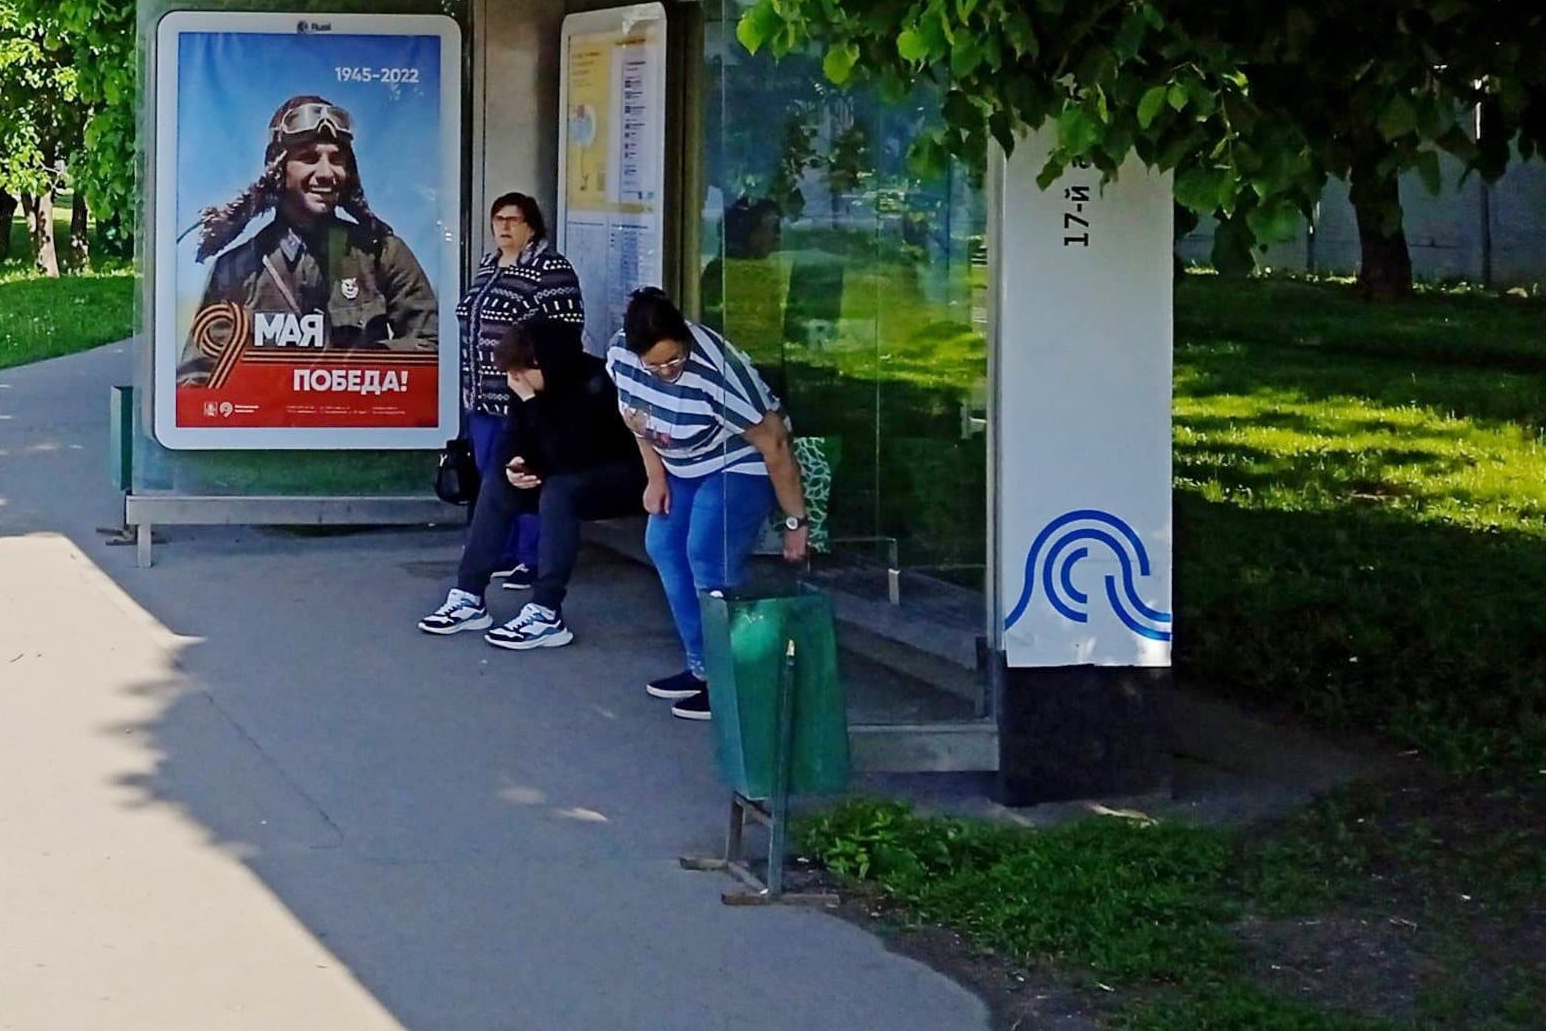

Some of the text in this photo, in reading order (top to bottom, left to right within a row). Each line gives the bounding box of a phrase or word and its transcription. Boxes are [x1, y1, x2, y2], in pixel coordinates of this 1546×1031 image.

[334, 66, 419, 83] 1945-2022
[1063, 185, 1090, 247] 17-й
[254, 312, 325, 347] МАЯ
[293, 369, 409, 395] ПОБЕДА!
